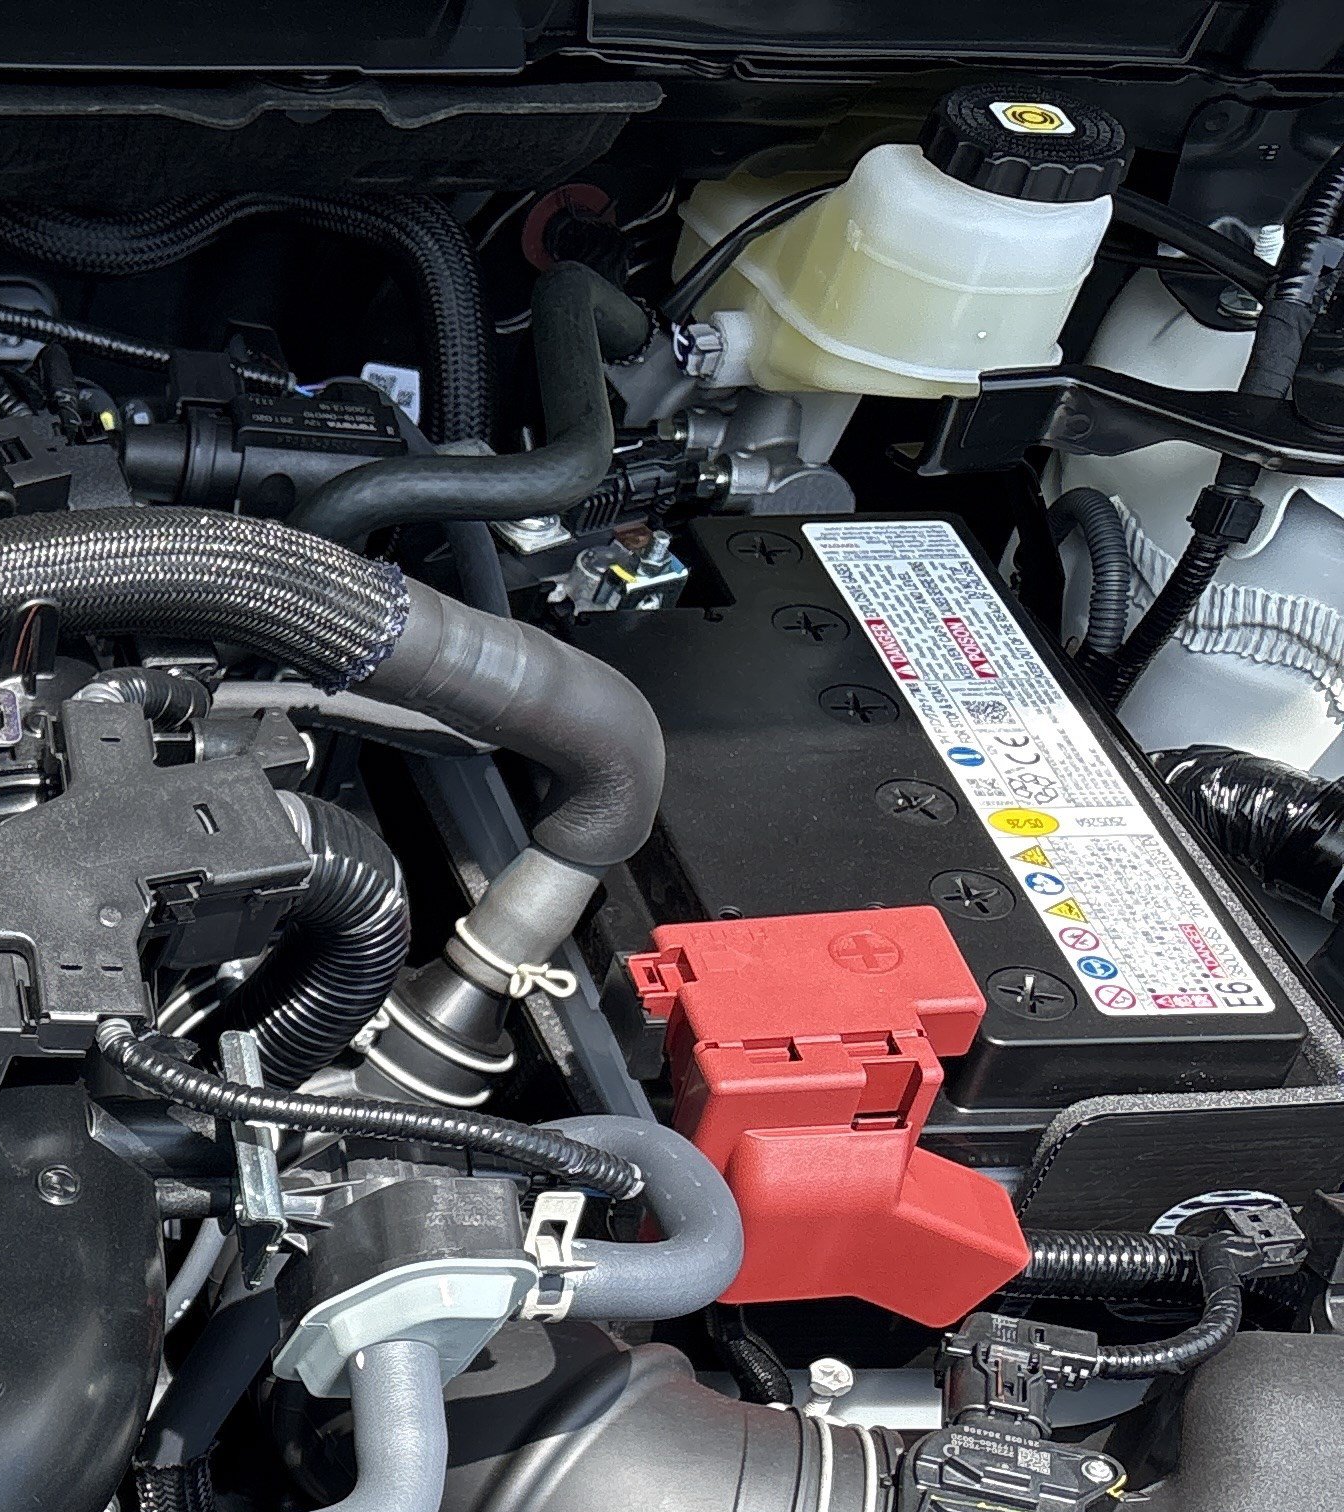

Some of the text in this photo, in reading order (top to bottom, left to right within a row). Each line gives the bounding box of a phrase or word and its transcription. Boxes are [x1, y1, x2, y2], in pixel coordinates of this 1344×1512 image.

[868, 623, 908, 662] DANGER
[945, 621, 987, 661] POISON
[923, 681, 949, 703] START
[941, 710, 965, 727] STOP
[1179, 924, 1220, 967] DANGER
[1211, 980, 1264, 1007] E6
